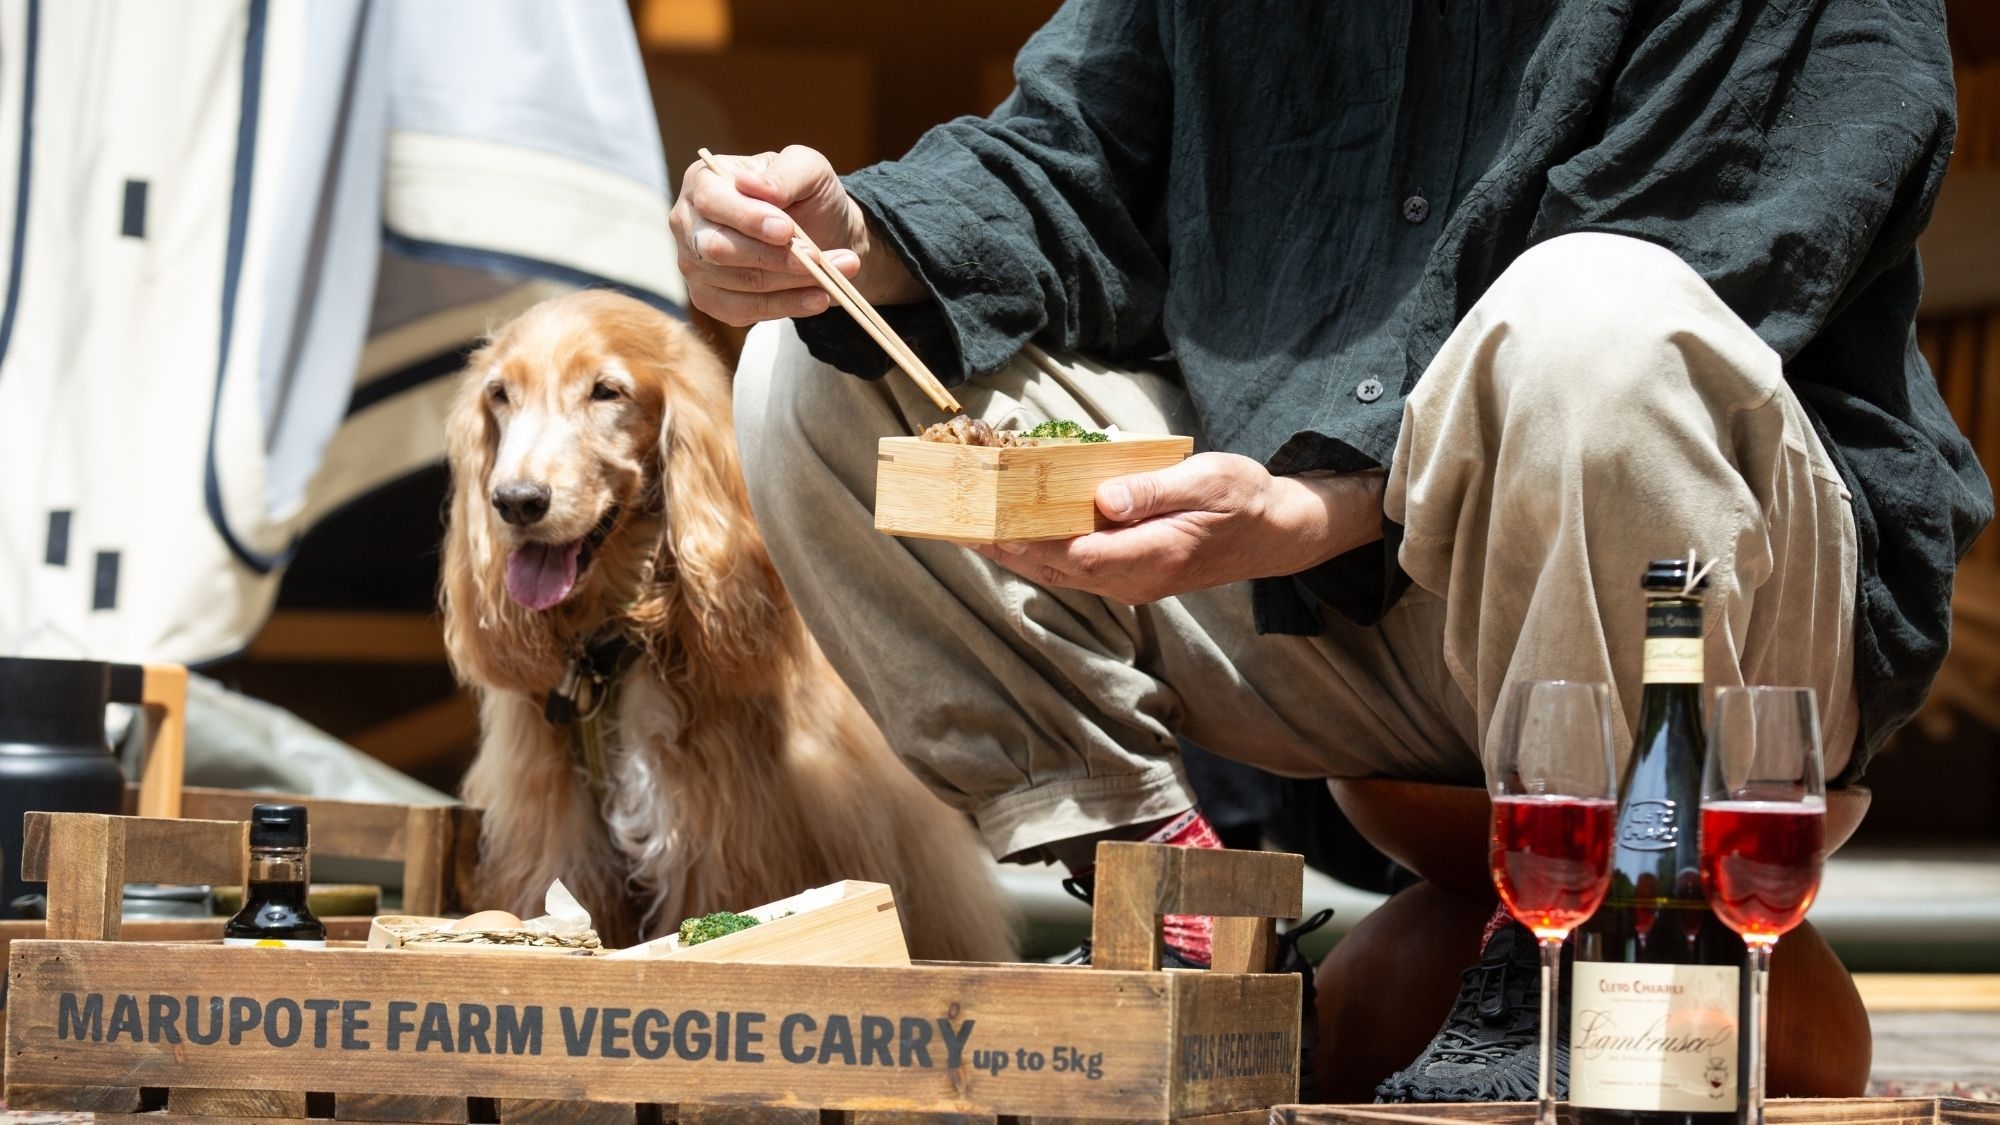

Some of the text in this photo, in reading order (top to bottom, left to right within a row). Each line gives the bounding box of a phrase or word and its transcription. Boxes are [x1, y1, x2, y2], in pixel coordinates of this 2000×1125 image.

[57, 992, 1104, 1081] MARUPOTE FARM VEGGIE CARRY up to 5kg
